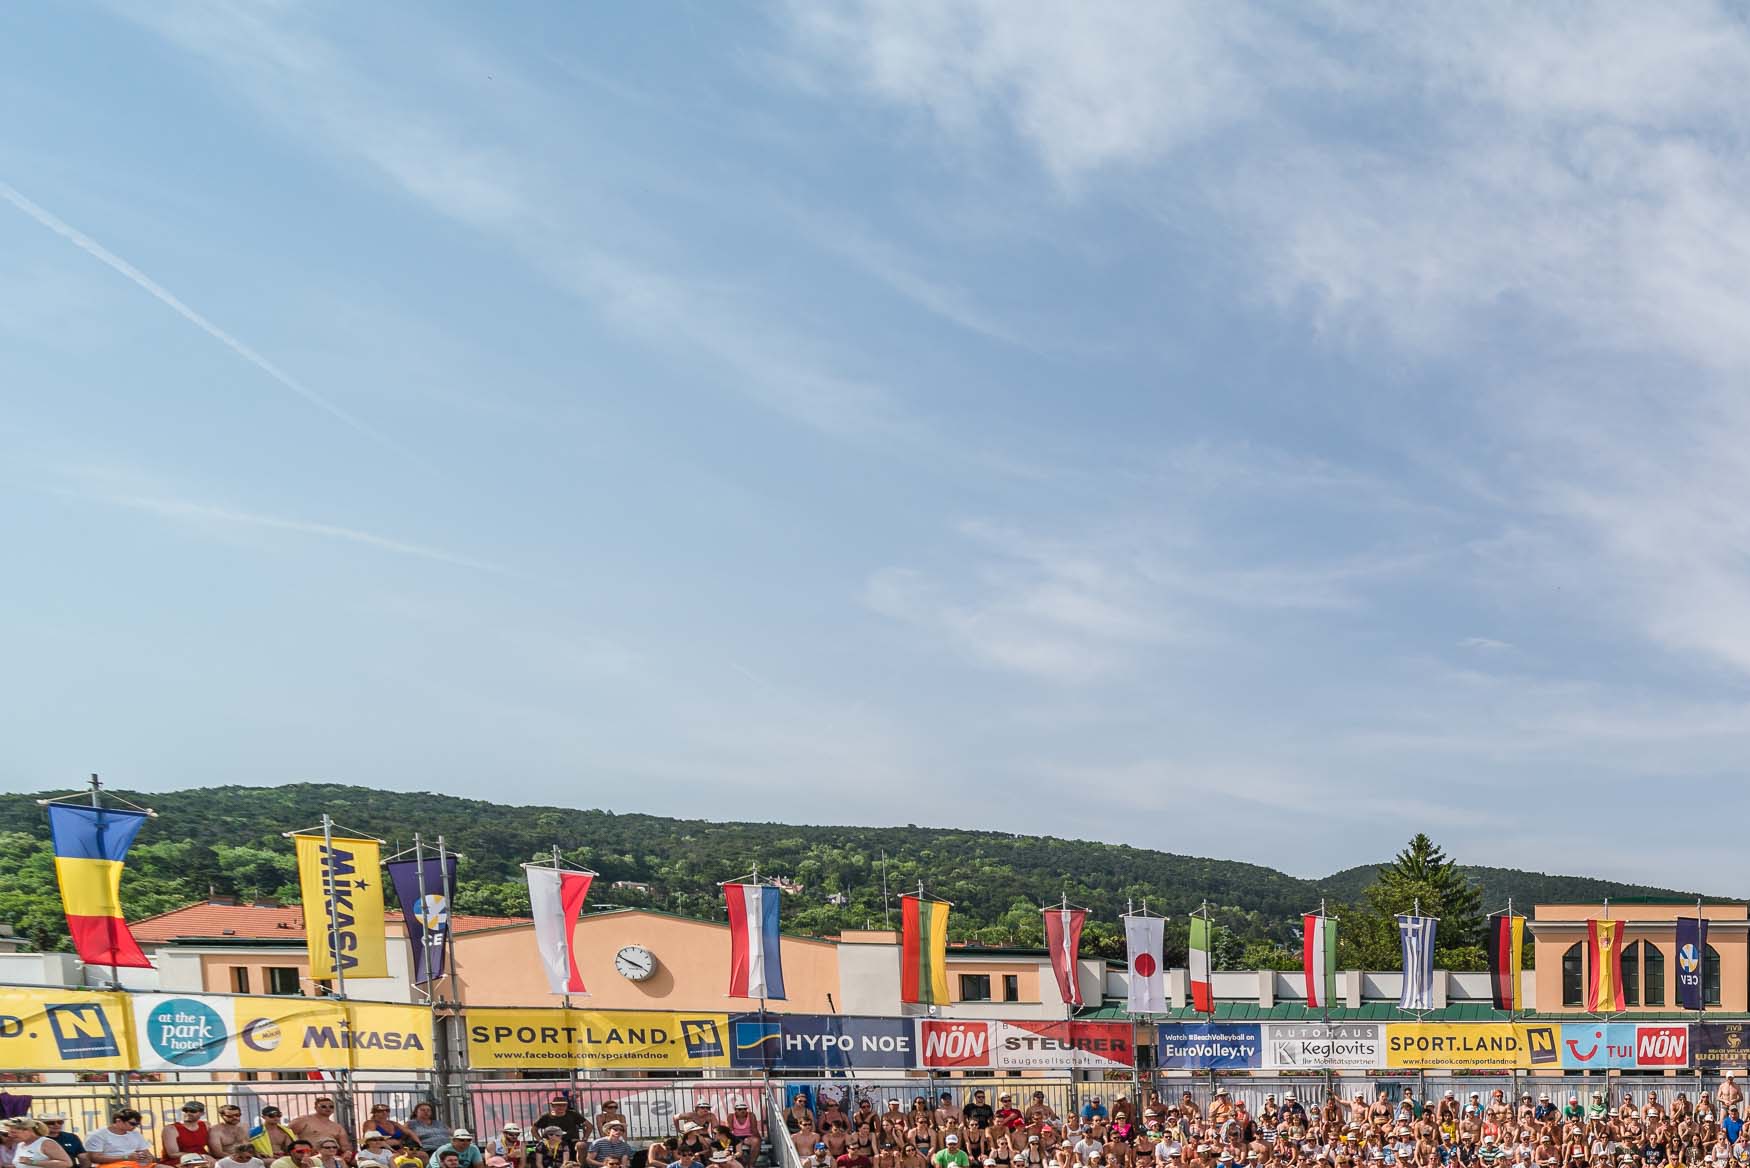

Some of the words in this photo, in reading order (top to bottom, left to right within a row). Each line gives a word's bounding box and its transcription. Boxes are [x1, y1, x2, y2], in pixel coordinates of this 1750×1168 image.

[158, 1014, 171, 1023] at
[175, 1012, 197, 1023] the
[161, 1016, 213, 1046] park
[472, 1026, 676, 1044] SPORT.LAND.
[1275, 1029, 1373, 1038] AUTOHAUS
[786, 1034, 854, 1052] HYPO
[862, 1036, 910, 1052] NOE
[926, 1025, 987, 1057] NÖN
[1004, 1036, 1127, 1051] STEURER
[1189, 1033, 1245, 1043] #BeachVolleyball
[1390, 1037, 1522, 1051] SPORT.LAND.
[1639, 1030, 1684, 1058] NÖN
[171, 1039, 204, 1051] hotel
[1166, 1044, 1255, 1059] EuroVolley.tv
[1301, 1041, 1375, 1058] Keglovits
[1606, 1045, 1633, 1058] TUI
[494, 1051, 669, 1061] www.facebook.com/sportlandnoe
[1003, 1057, 1091, 1065] Baugesellschaft
[1403, 1058, 1517, 1066] www.facebook.com/sportlandnoe
[1695, 1053, 1733, 1061] WORLD
